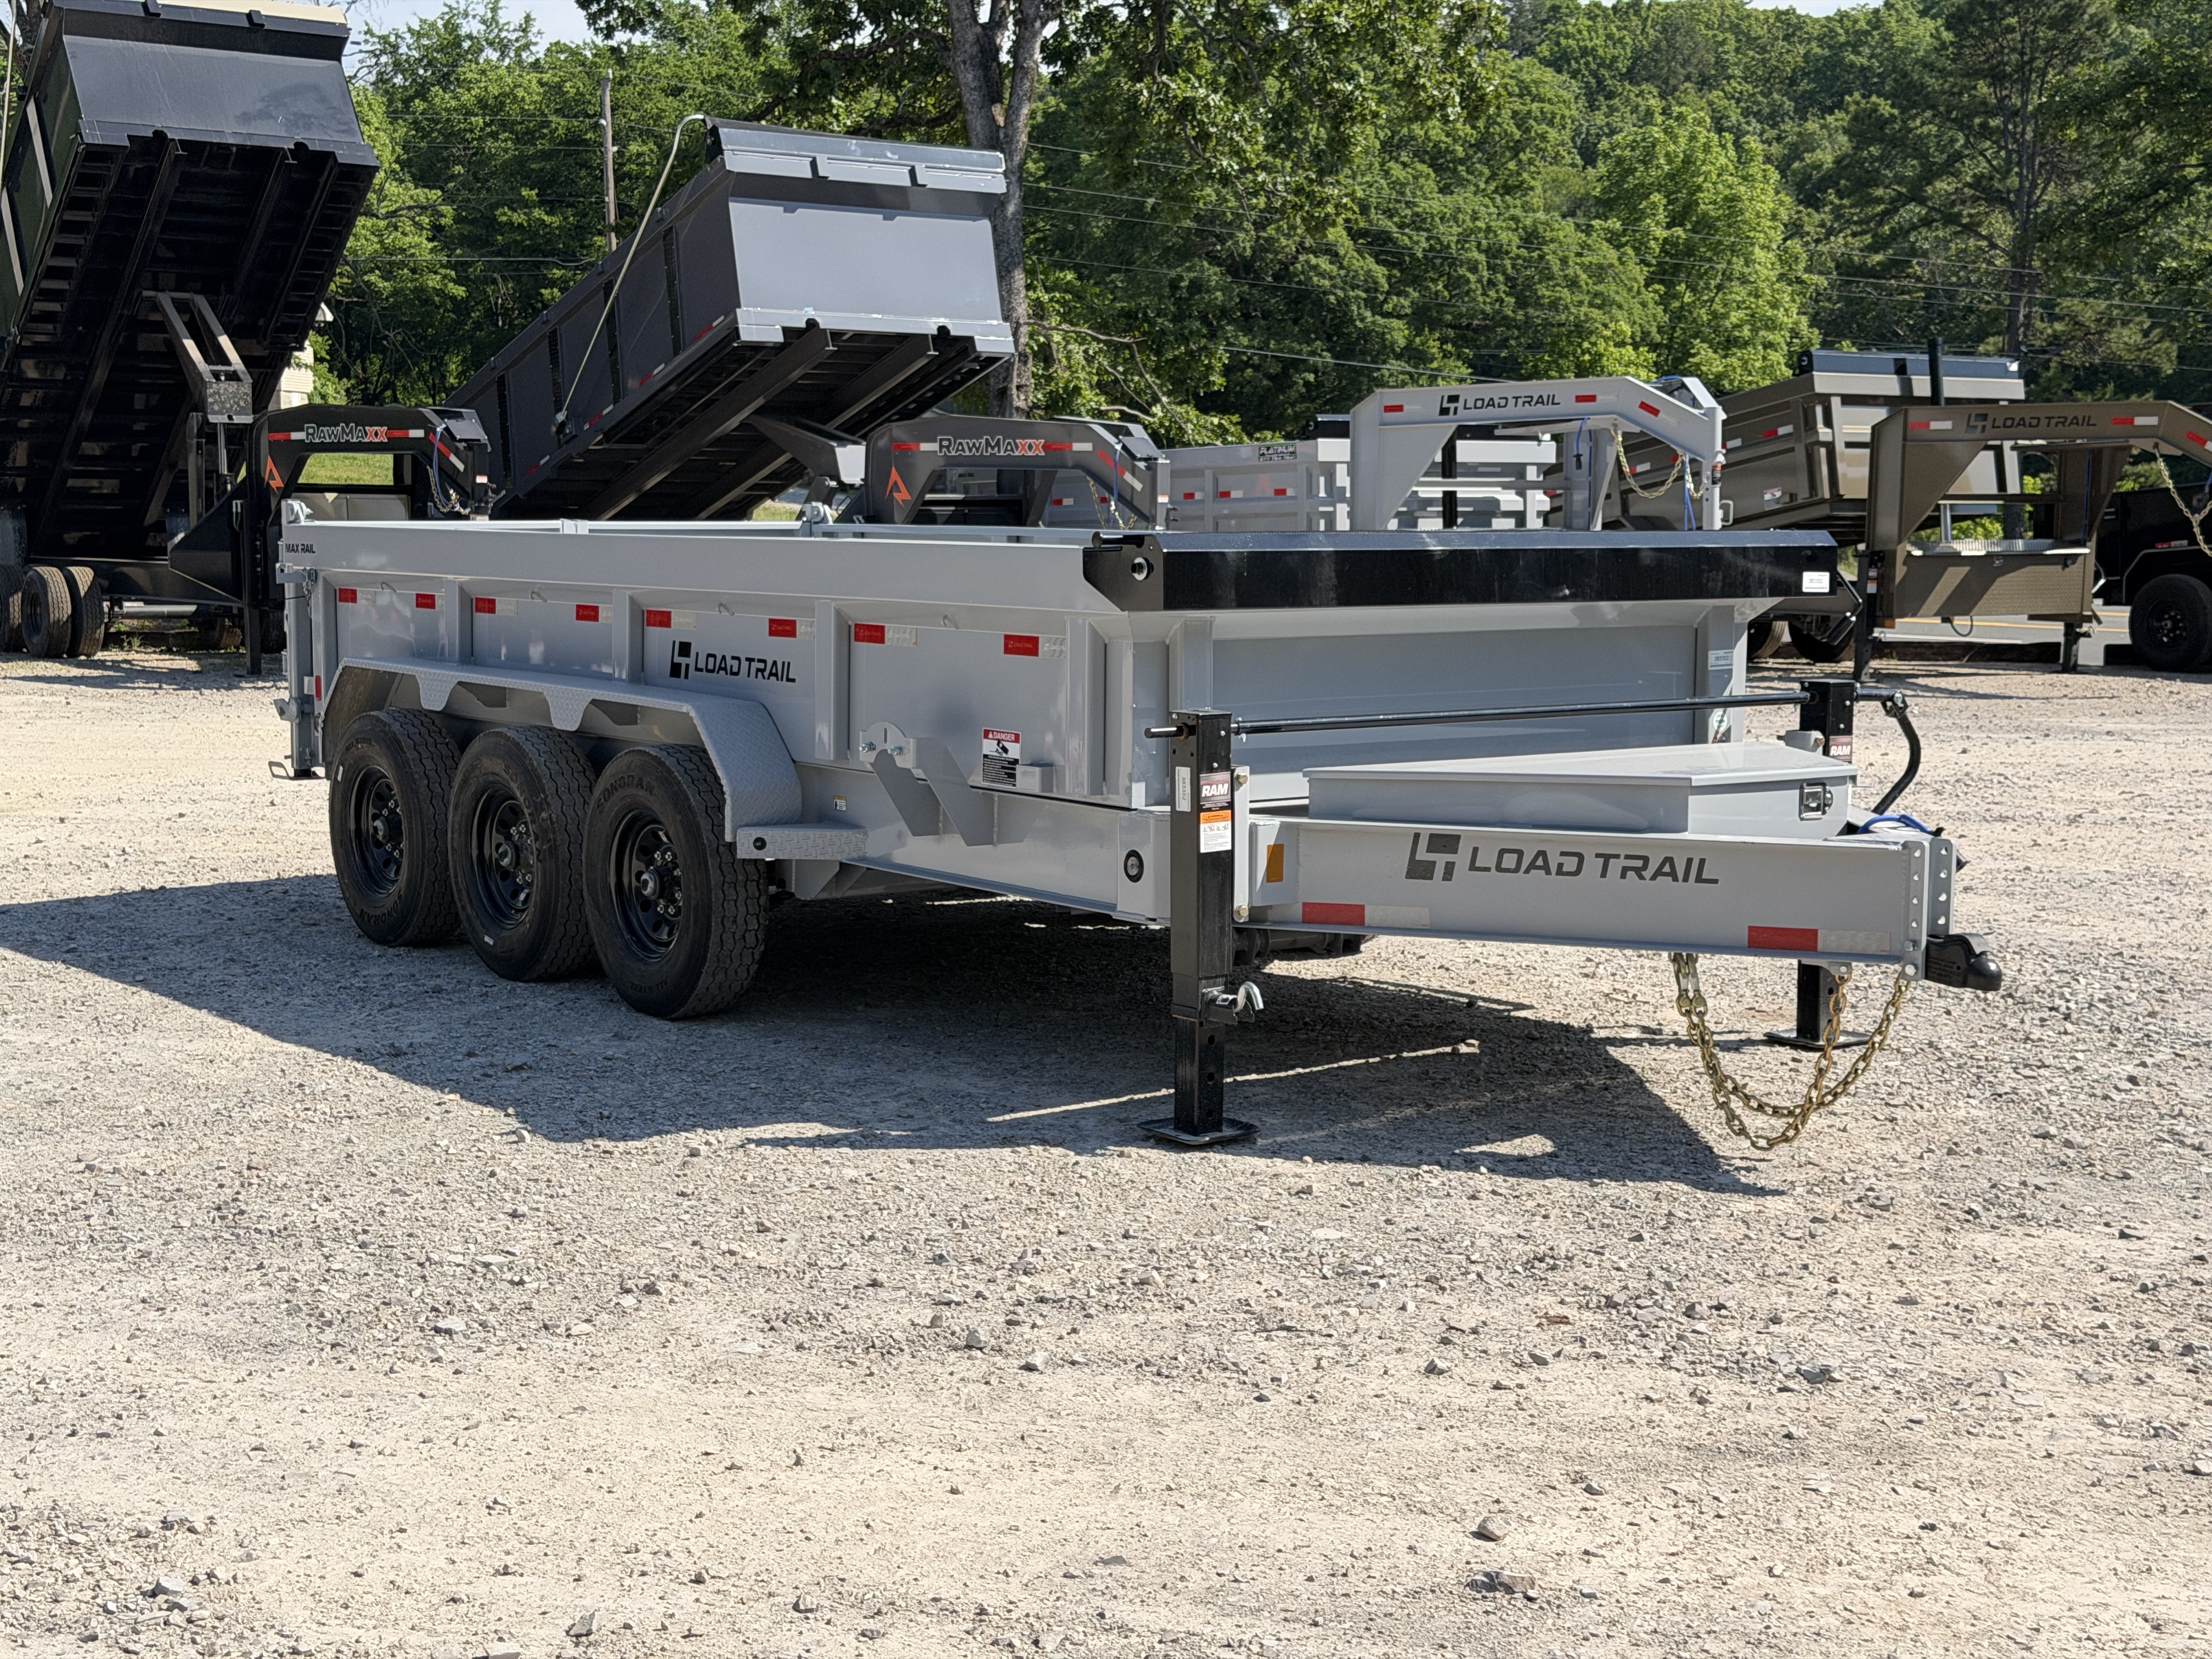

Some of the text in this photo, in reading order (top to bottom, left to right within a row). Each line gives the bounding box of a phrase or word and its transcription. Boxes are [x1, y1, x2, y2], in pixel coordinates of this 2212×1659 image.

[1463, 393, 1561, 410] LOAD TRAIL
[1991, 415, 2097, 429] LOAD TRAIL
[285, 543, 316, 554] MAX RAIL
[694, 651, 796, 683] LOAD TRAIL
[993, 731, 1015, 741] DANGER
[1830, 745, 1851, 756] RAM
[597, 774, 656, 814] SONORAN
[1201, 783, 1229, 797] RAM
[1468, 847, 1719, 884] LOAD TRAIL
